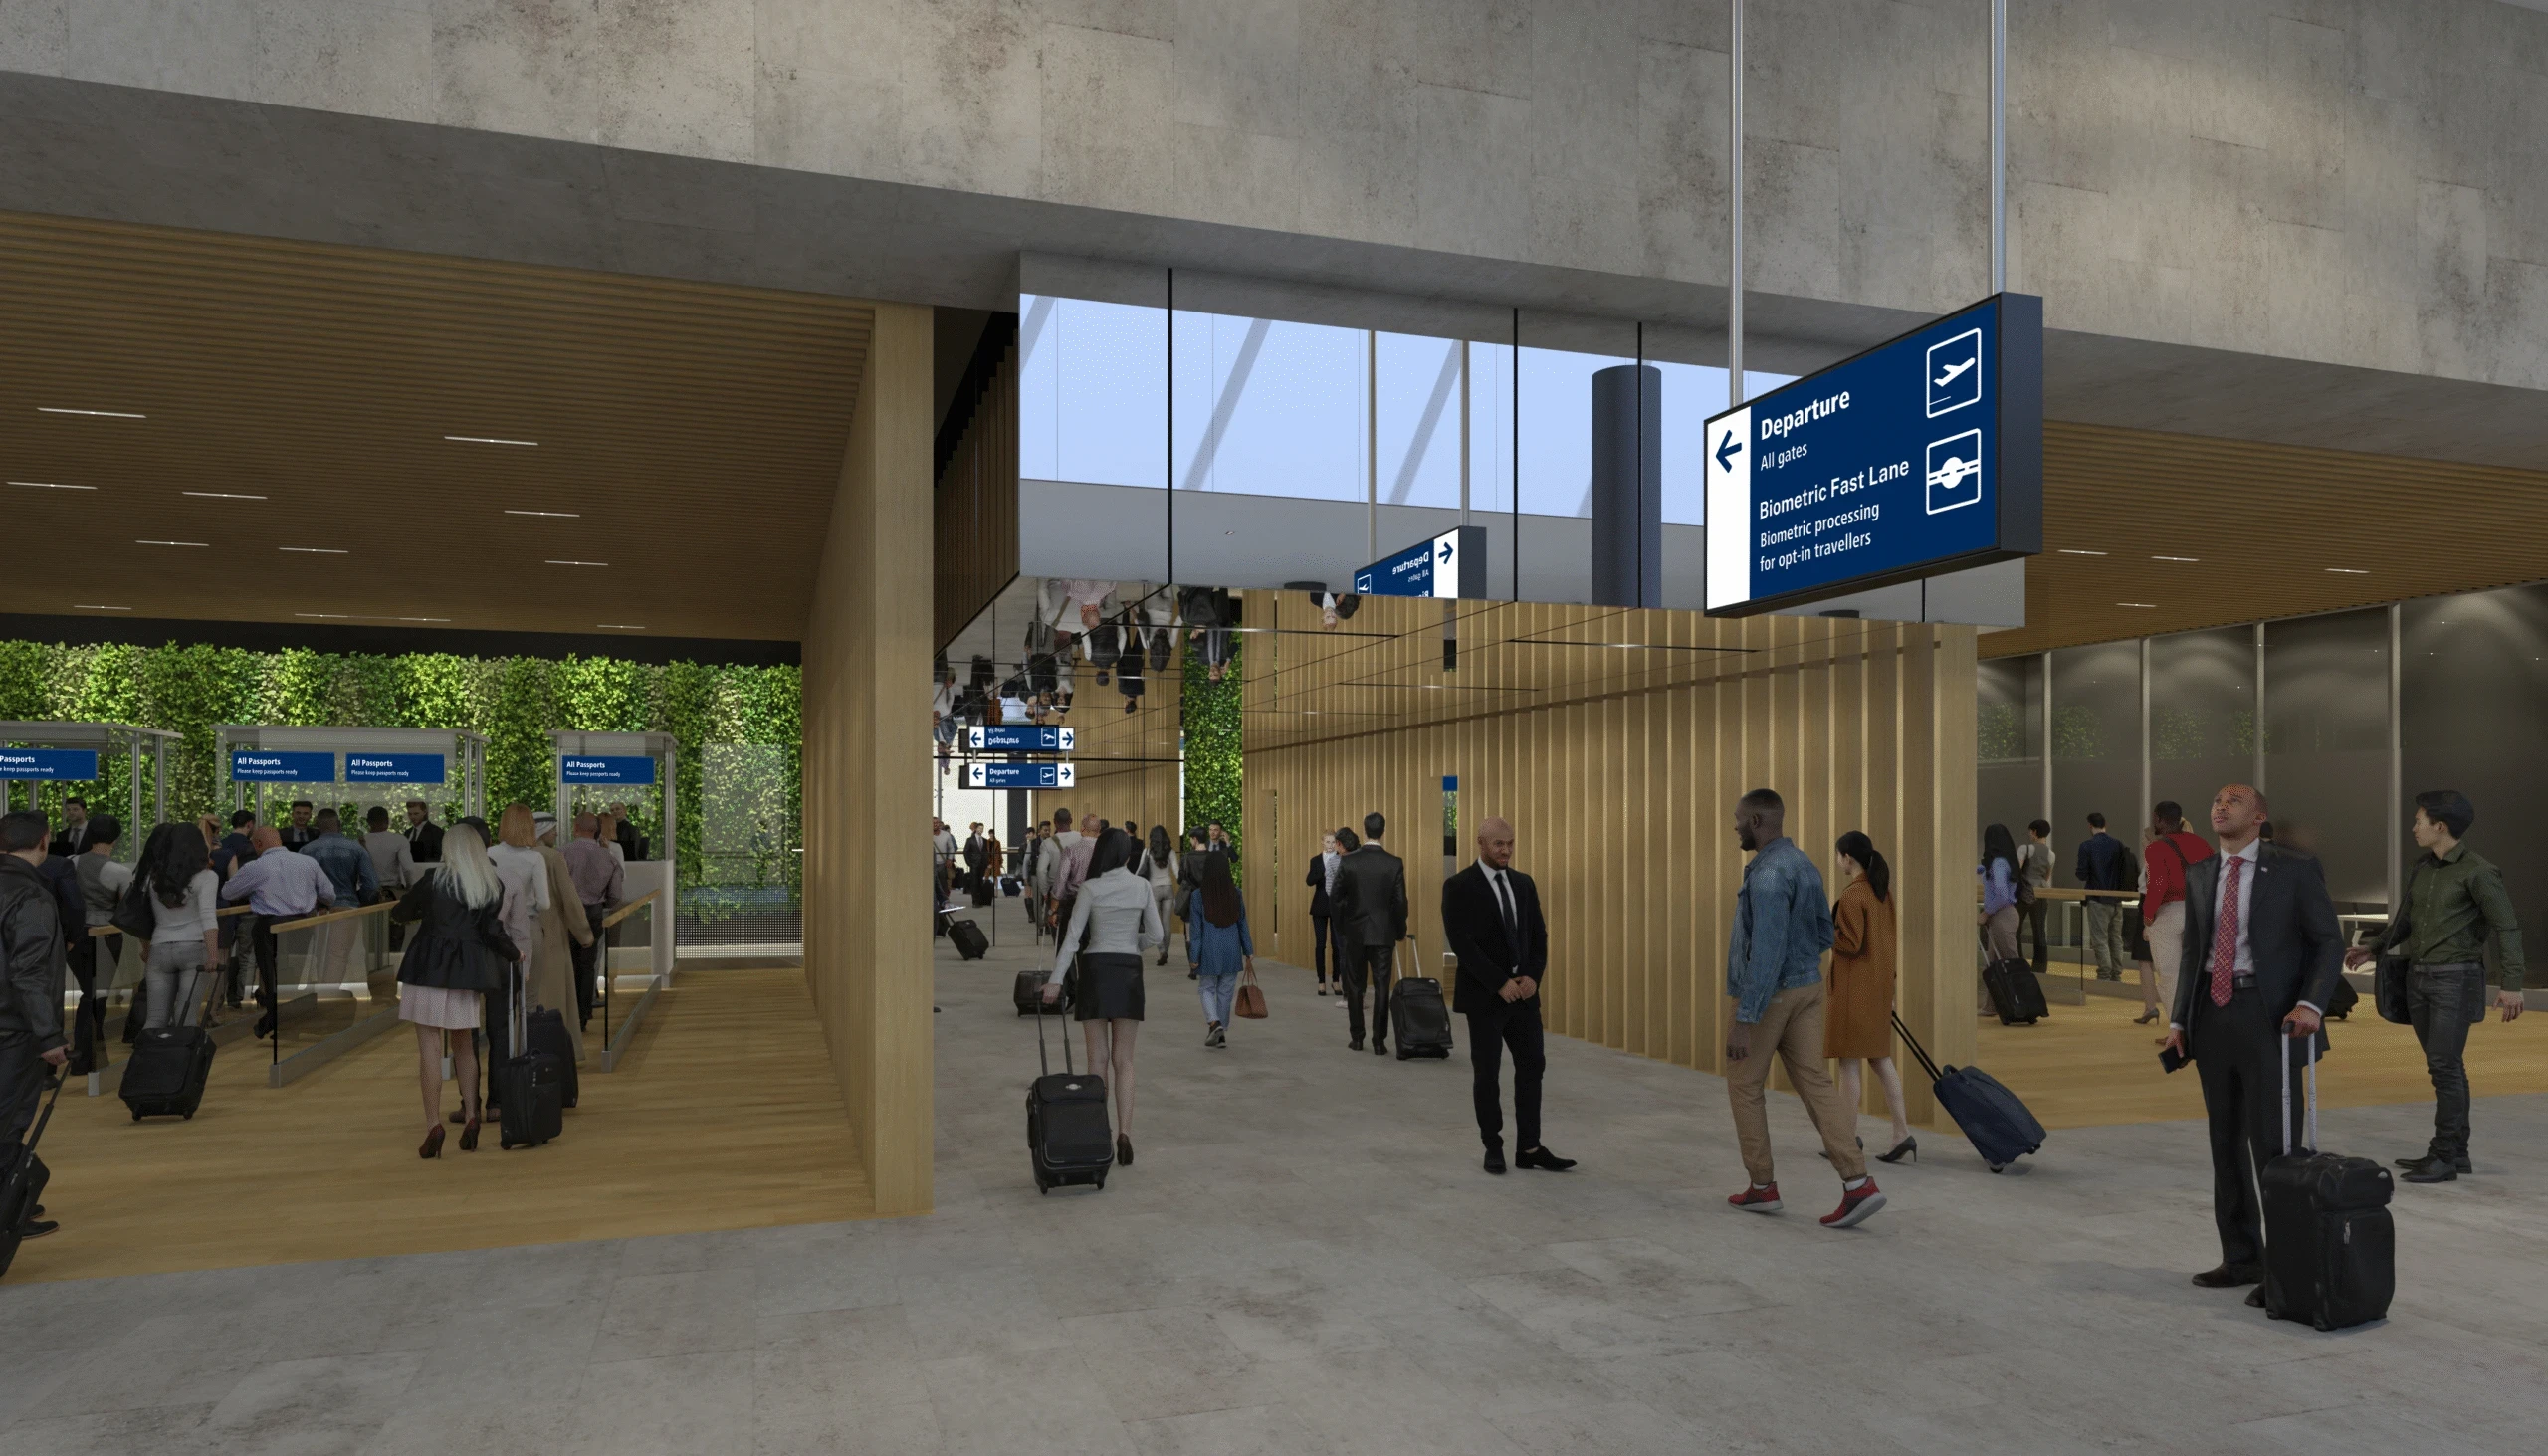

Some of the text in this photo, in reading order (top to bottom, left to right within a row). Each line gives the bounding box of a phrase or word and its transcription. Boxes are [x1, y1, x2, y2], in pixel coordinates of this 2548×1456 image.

[1761, 391, 1850, 440] Departure
[1760, 444, 1807, 471] All gates
[1760, 461, 1910, 519] Biometric Fast Lane
[1760, 504, 1880, 548] Biometric processing
[1760, 532, 1872, 572] for opt-in travellers
[361, 759, 393, 768] Passports
